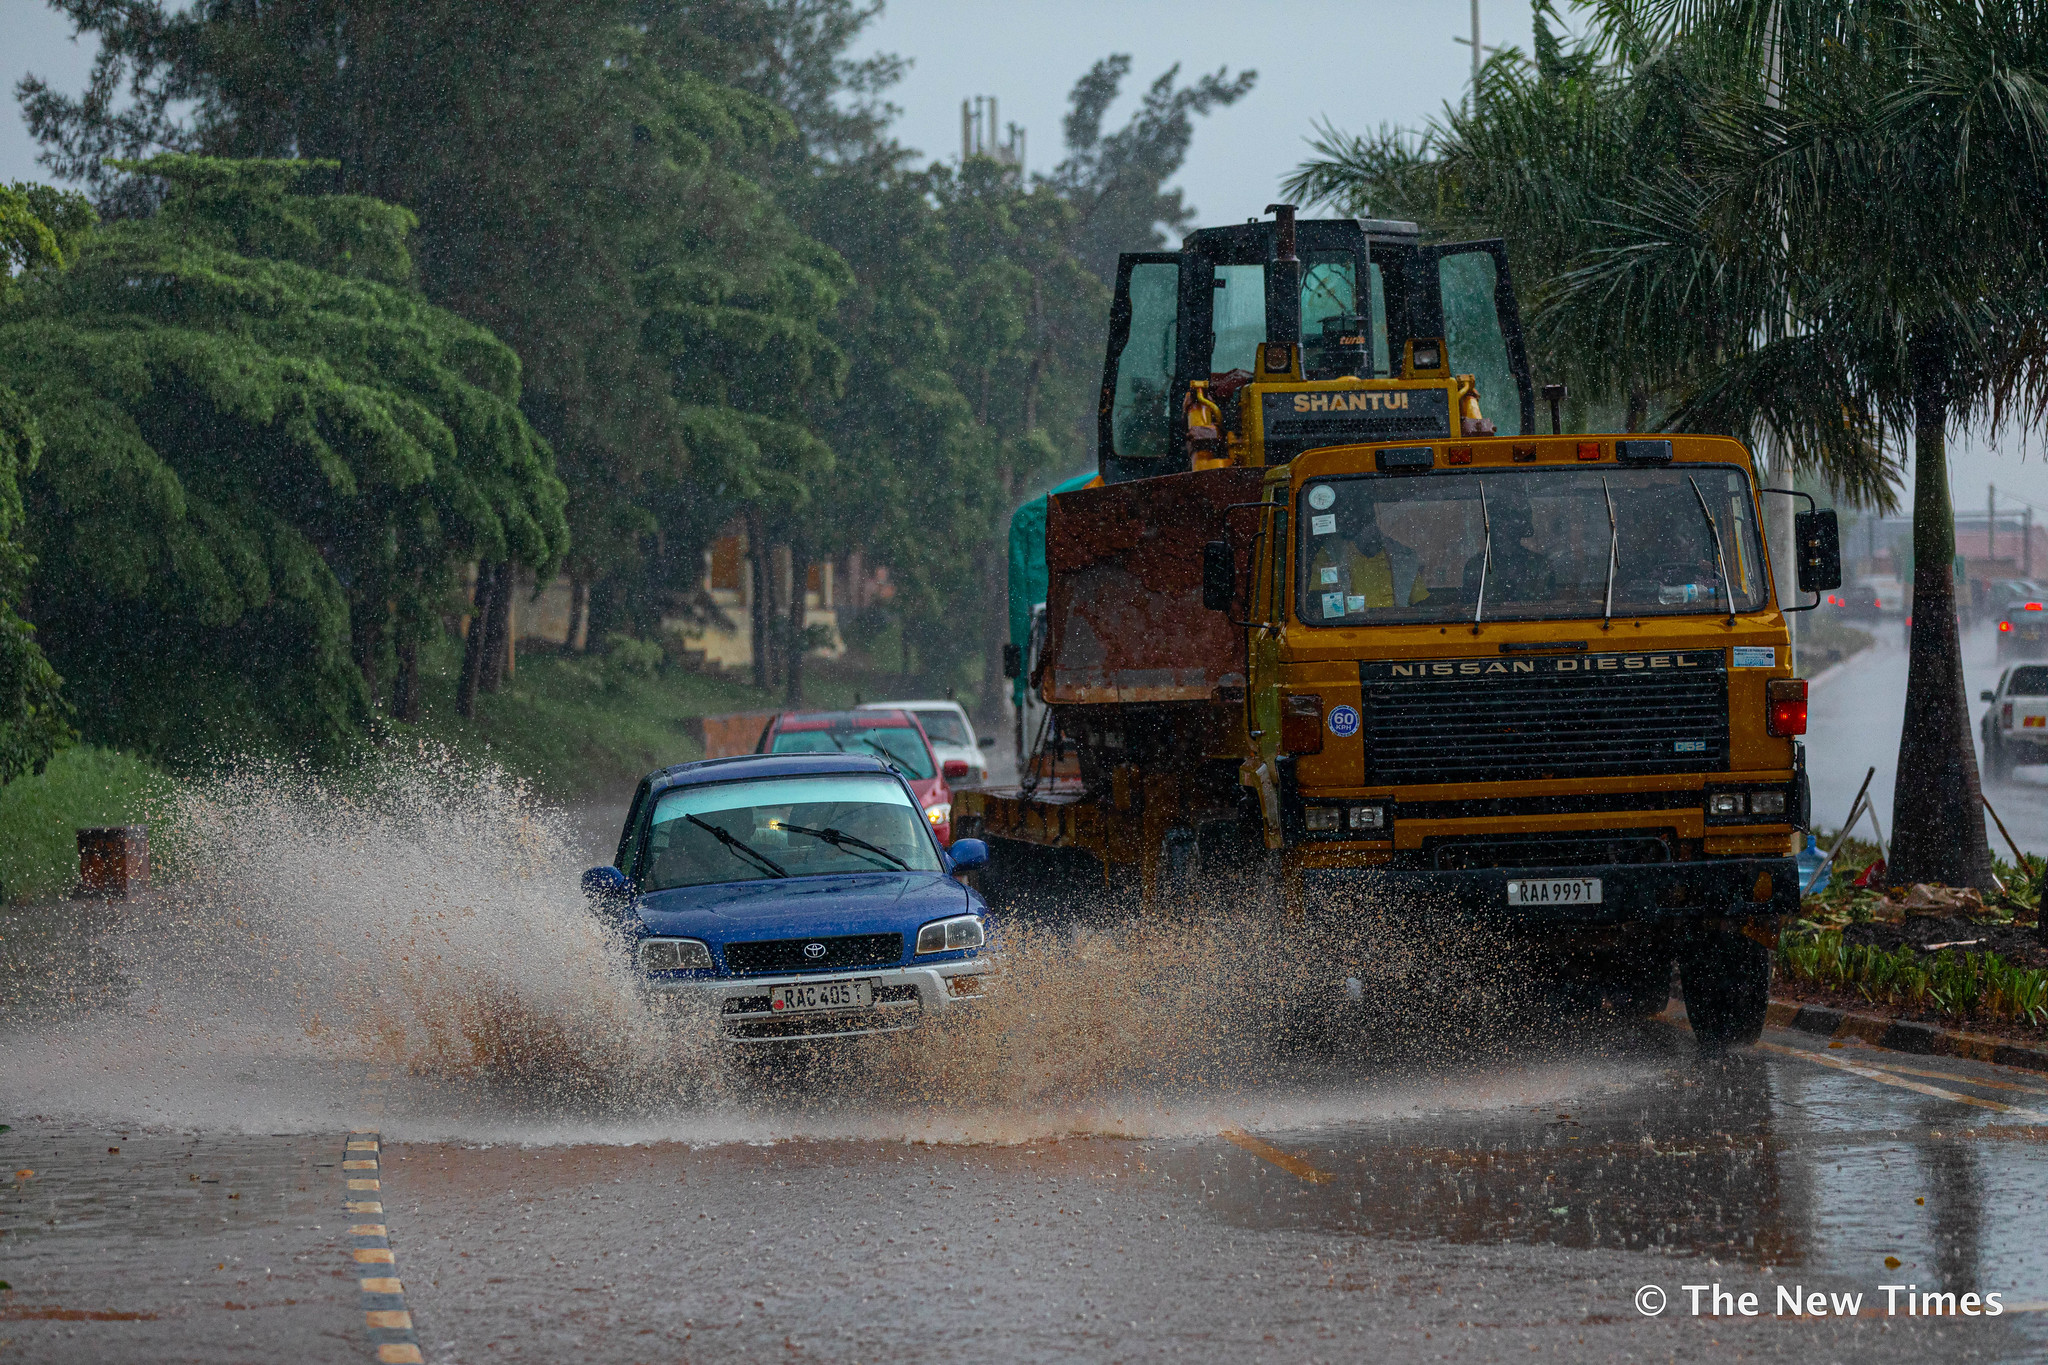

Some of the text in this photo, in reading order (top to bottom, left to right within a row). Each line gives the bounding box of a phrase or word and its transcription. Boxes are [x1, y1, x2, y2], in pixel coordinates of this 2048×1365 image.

[1293, 392, 1409, 412] SHANTUI
[1391, 655, 1698, 676] NISSAN DIESEL
[1334, 712, 1354, 725] 60
